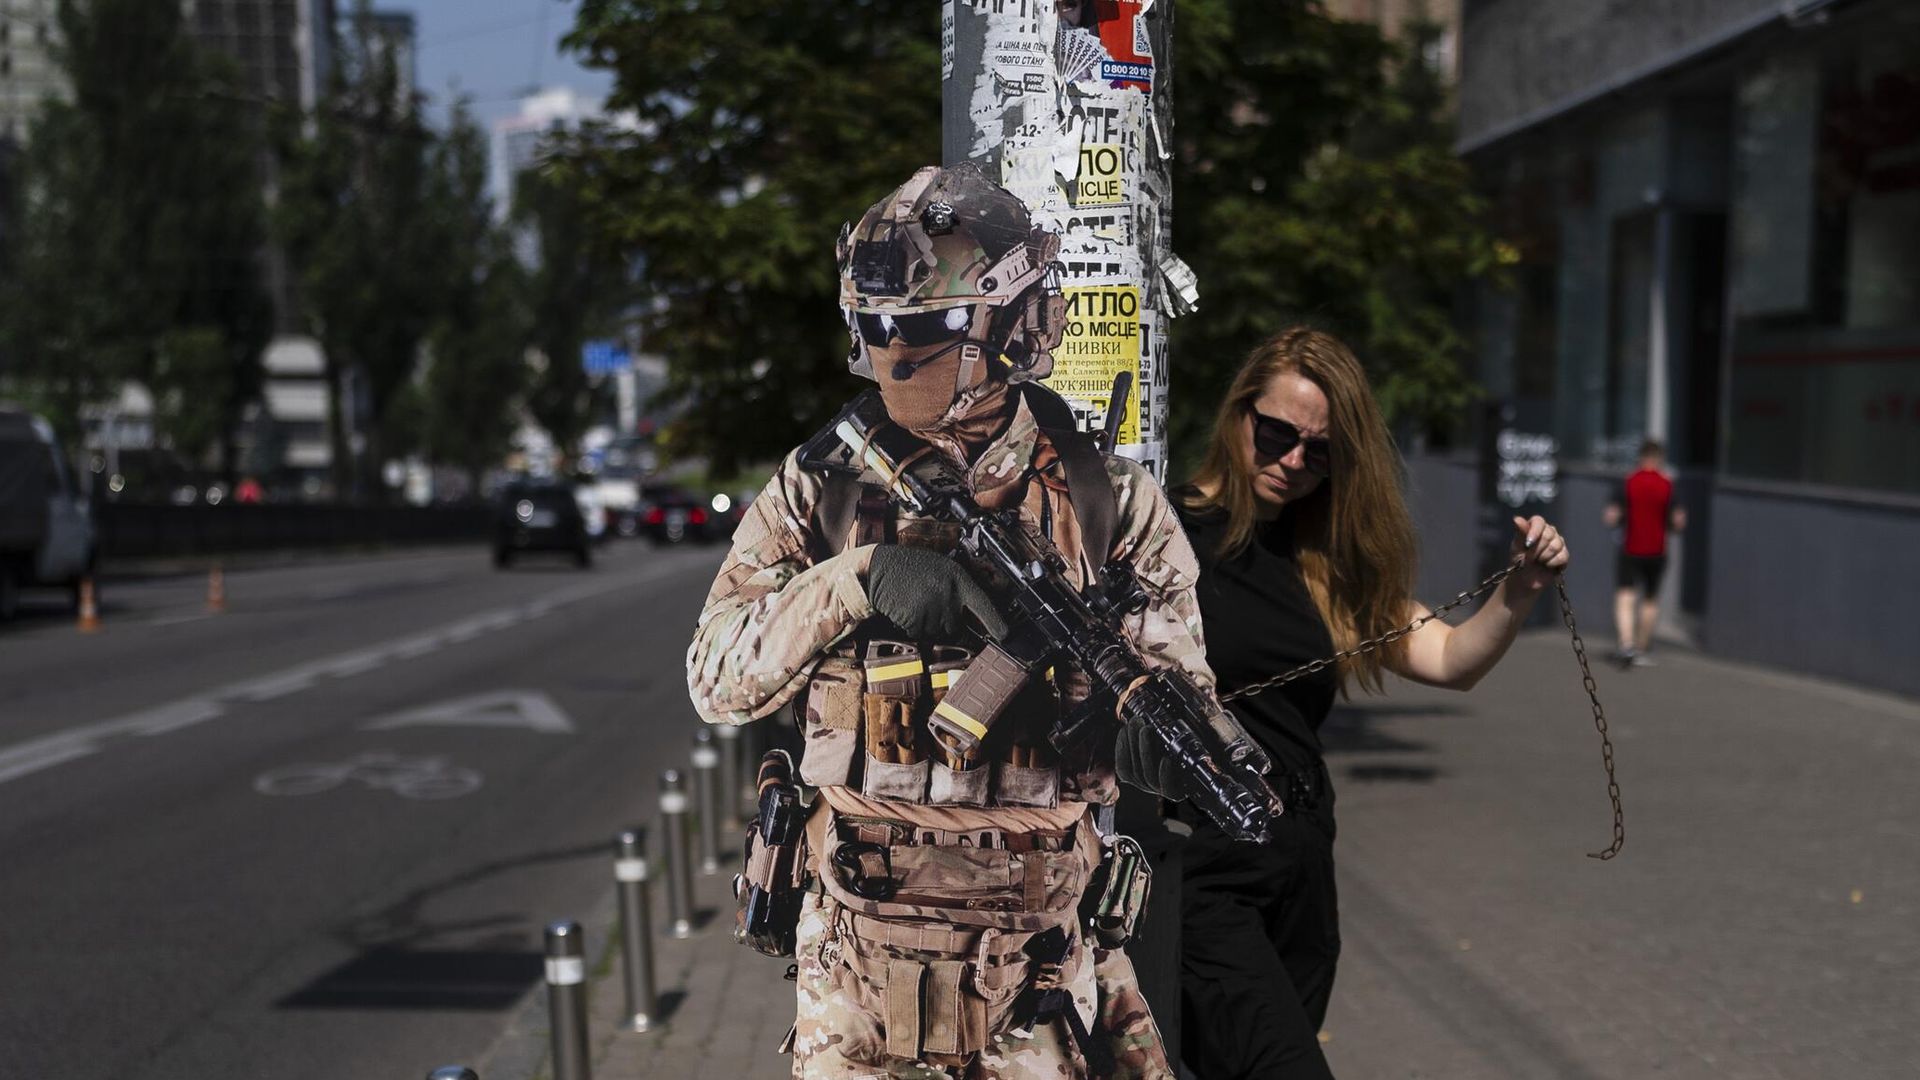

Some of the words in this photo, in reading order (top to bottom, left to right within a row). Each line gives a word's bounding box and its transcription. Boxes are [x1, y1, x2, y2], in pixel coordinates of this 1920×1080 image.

[996, 55, 1020, 65] ОВОГО
[1104, 64, 1110, 73] 0
[1111, 64, 1128, 74] 800
[1128, 66, 1139, 75] 20
[1140, 67, 1148, 76] 10
[1080, 180, 1118, 199] ІСЦЕ
[1061, 291, 1137, 317] ИТЛО
[1062, 321, 1084, 337] КО
[1089, 321, 1137, 340] МІСЦЕ
[1066, 341, 1121, 355] НИВКИ
[1054, 359, 1072, 367] ект
[1052, 380, 1114, 391] ЛУК'ЯНІВС
